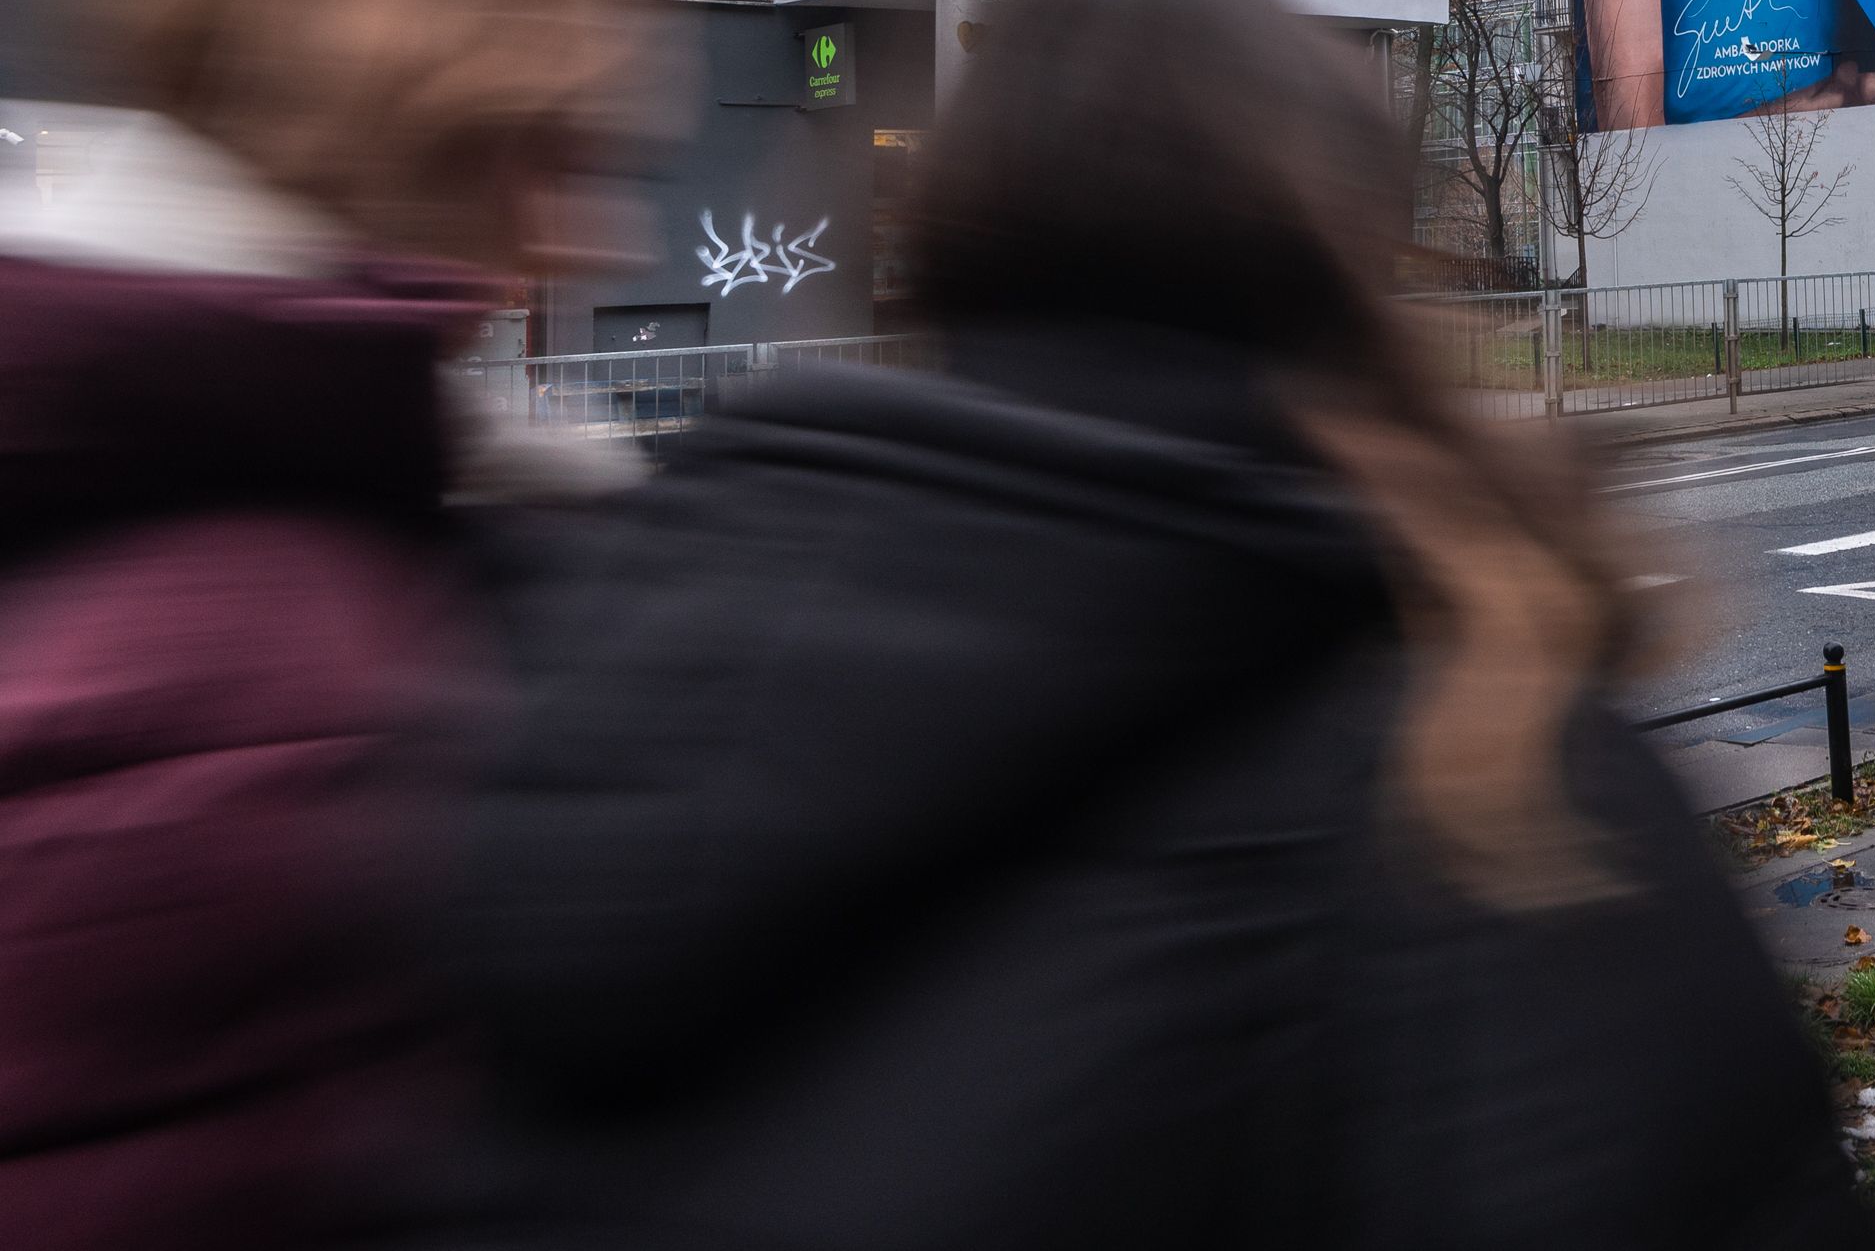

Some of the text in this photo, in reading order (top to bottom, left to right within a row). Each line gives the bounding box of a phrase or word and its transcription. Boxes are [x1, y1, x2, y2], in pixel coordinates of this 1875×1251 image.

[1697, 53, 1821, 80] ZDROWYCH NAWYKÓW
[809, 73, 841, 87] Carrefour
[814, 88, 837, 99] express
